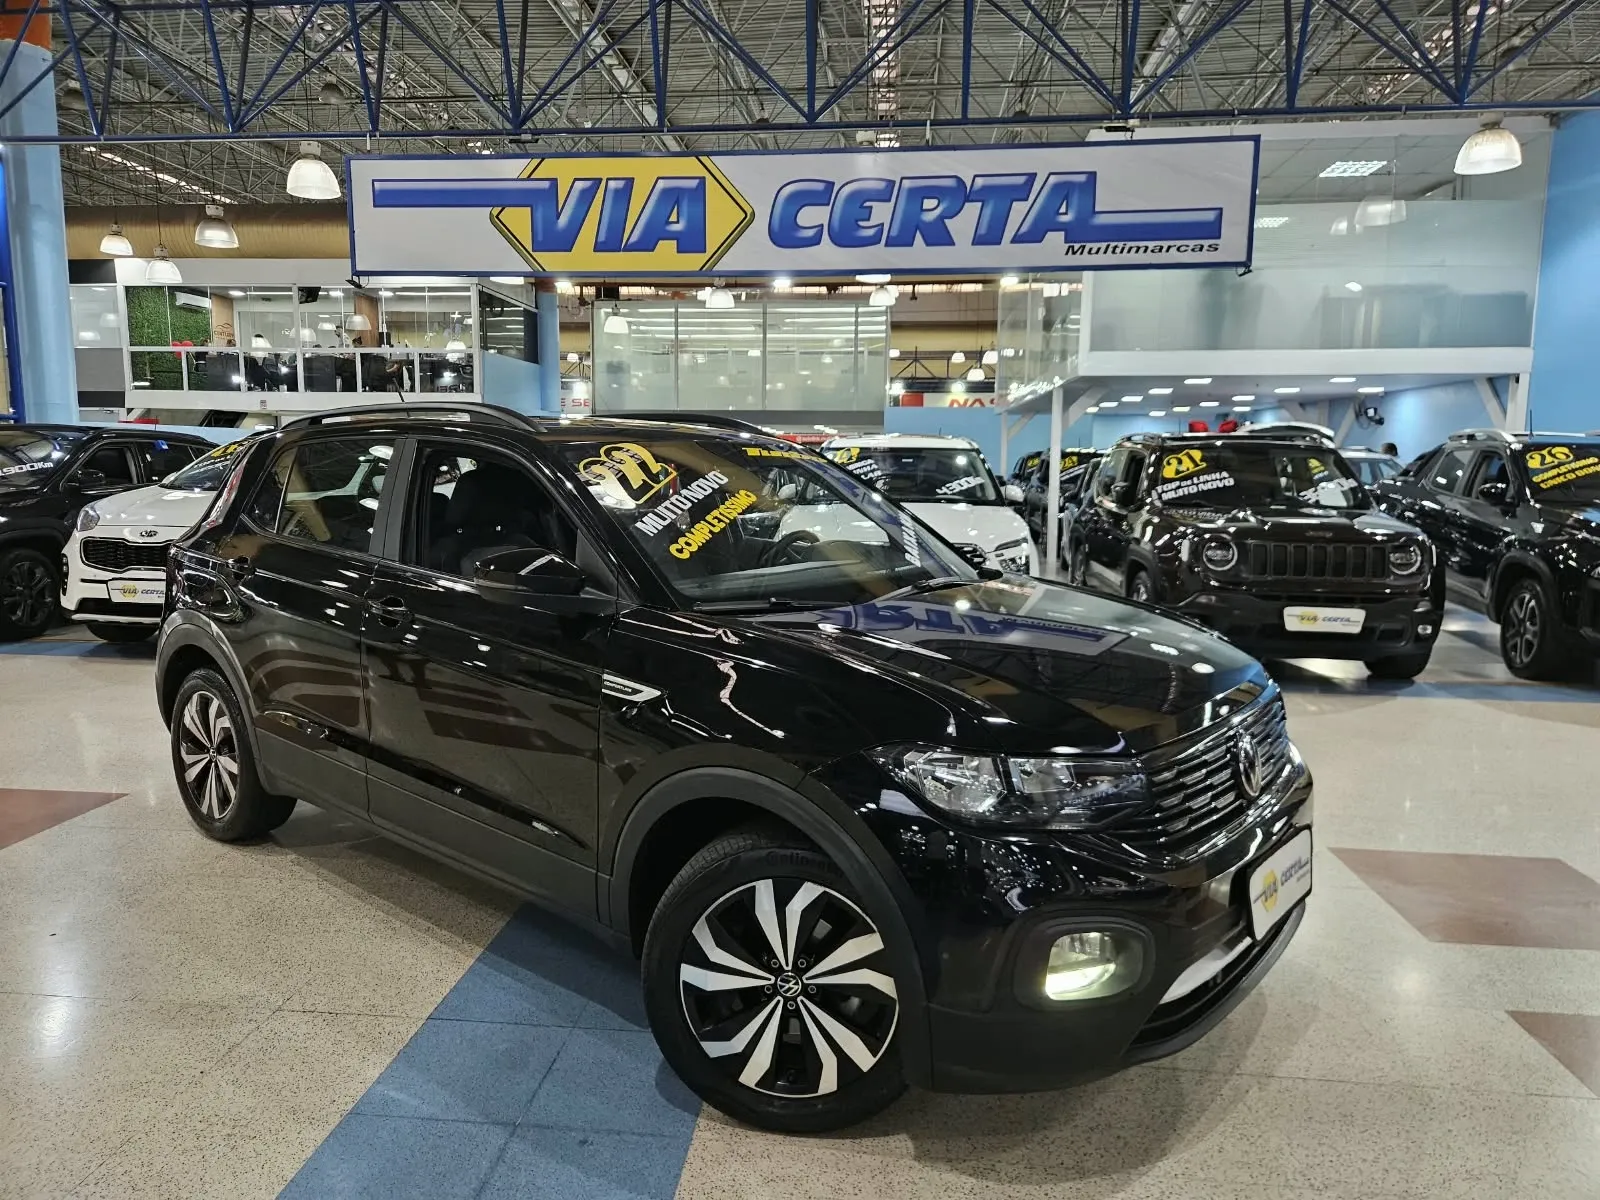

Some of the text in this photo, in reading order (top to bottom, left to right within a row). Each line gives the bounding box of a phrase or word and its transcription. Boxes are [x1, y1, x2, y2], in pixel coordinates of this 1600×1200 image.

[529, 171, 1098, 253] VIA CERTA
[1064, 242, 1221, 256] Multimarcas
[1163, 449, 1207, 478] 21
[1526, 446, 1574, 469] 26
[1161, 485, 1198, 501] MUITO
[1198, 477, 1235, 492] NOVO
[1192, 471, 1230, 484] LINHA
[634, 470, 729, 537] MUITO NOVO
